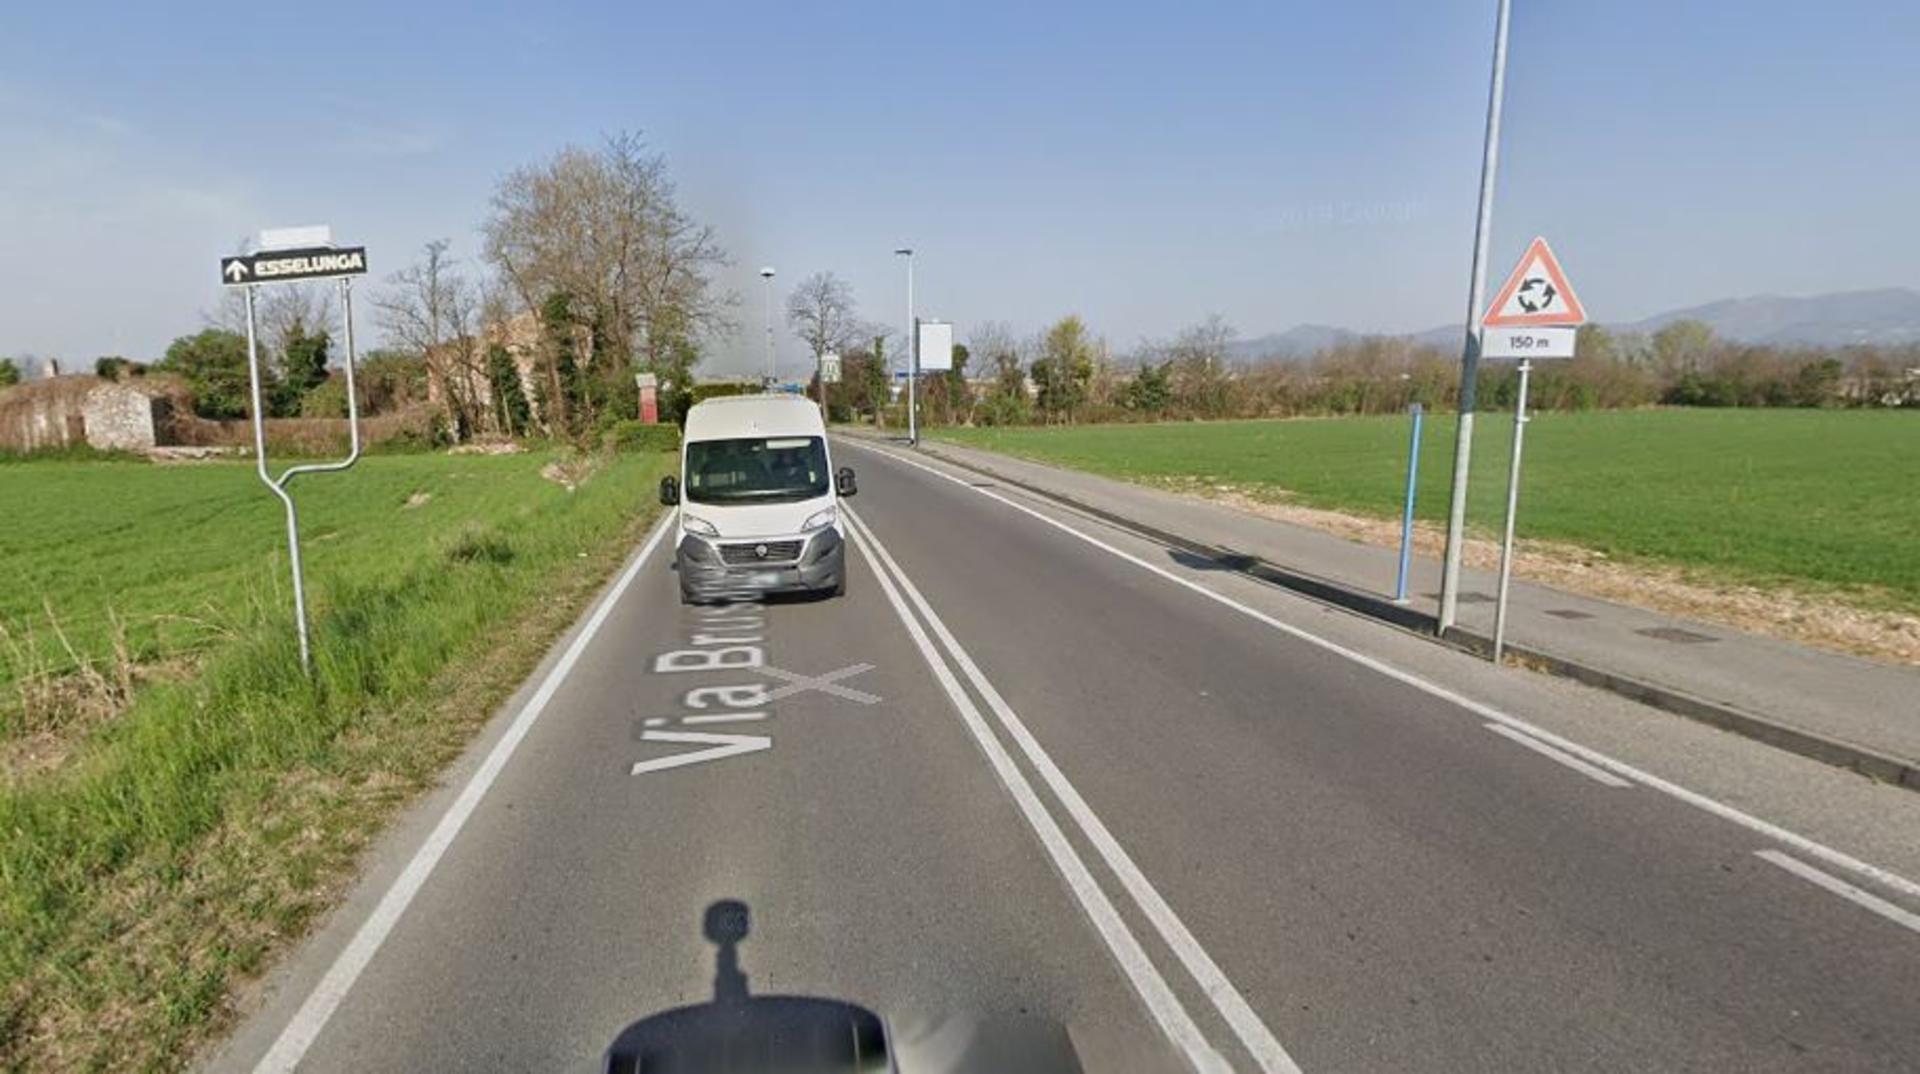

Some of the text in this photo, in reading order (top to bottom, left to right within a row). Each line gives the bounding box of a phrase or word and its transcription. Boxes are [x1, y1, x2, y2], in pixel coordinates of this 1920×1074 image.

[254, 252, 362, 276] ESSELUNGA
[1509, 336, 1549, 350] 150 m
